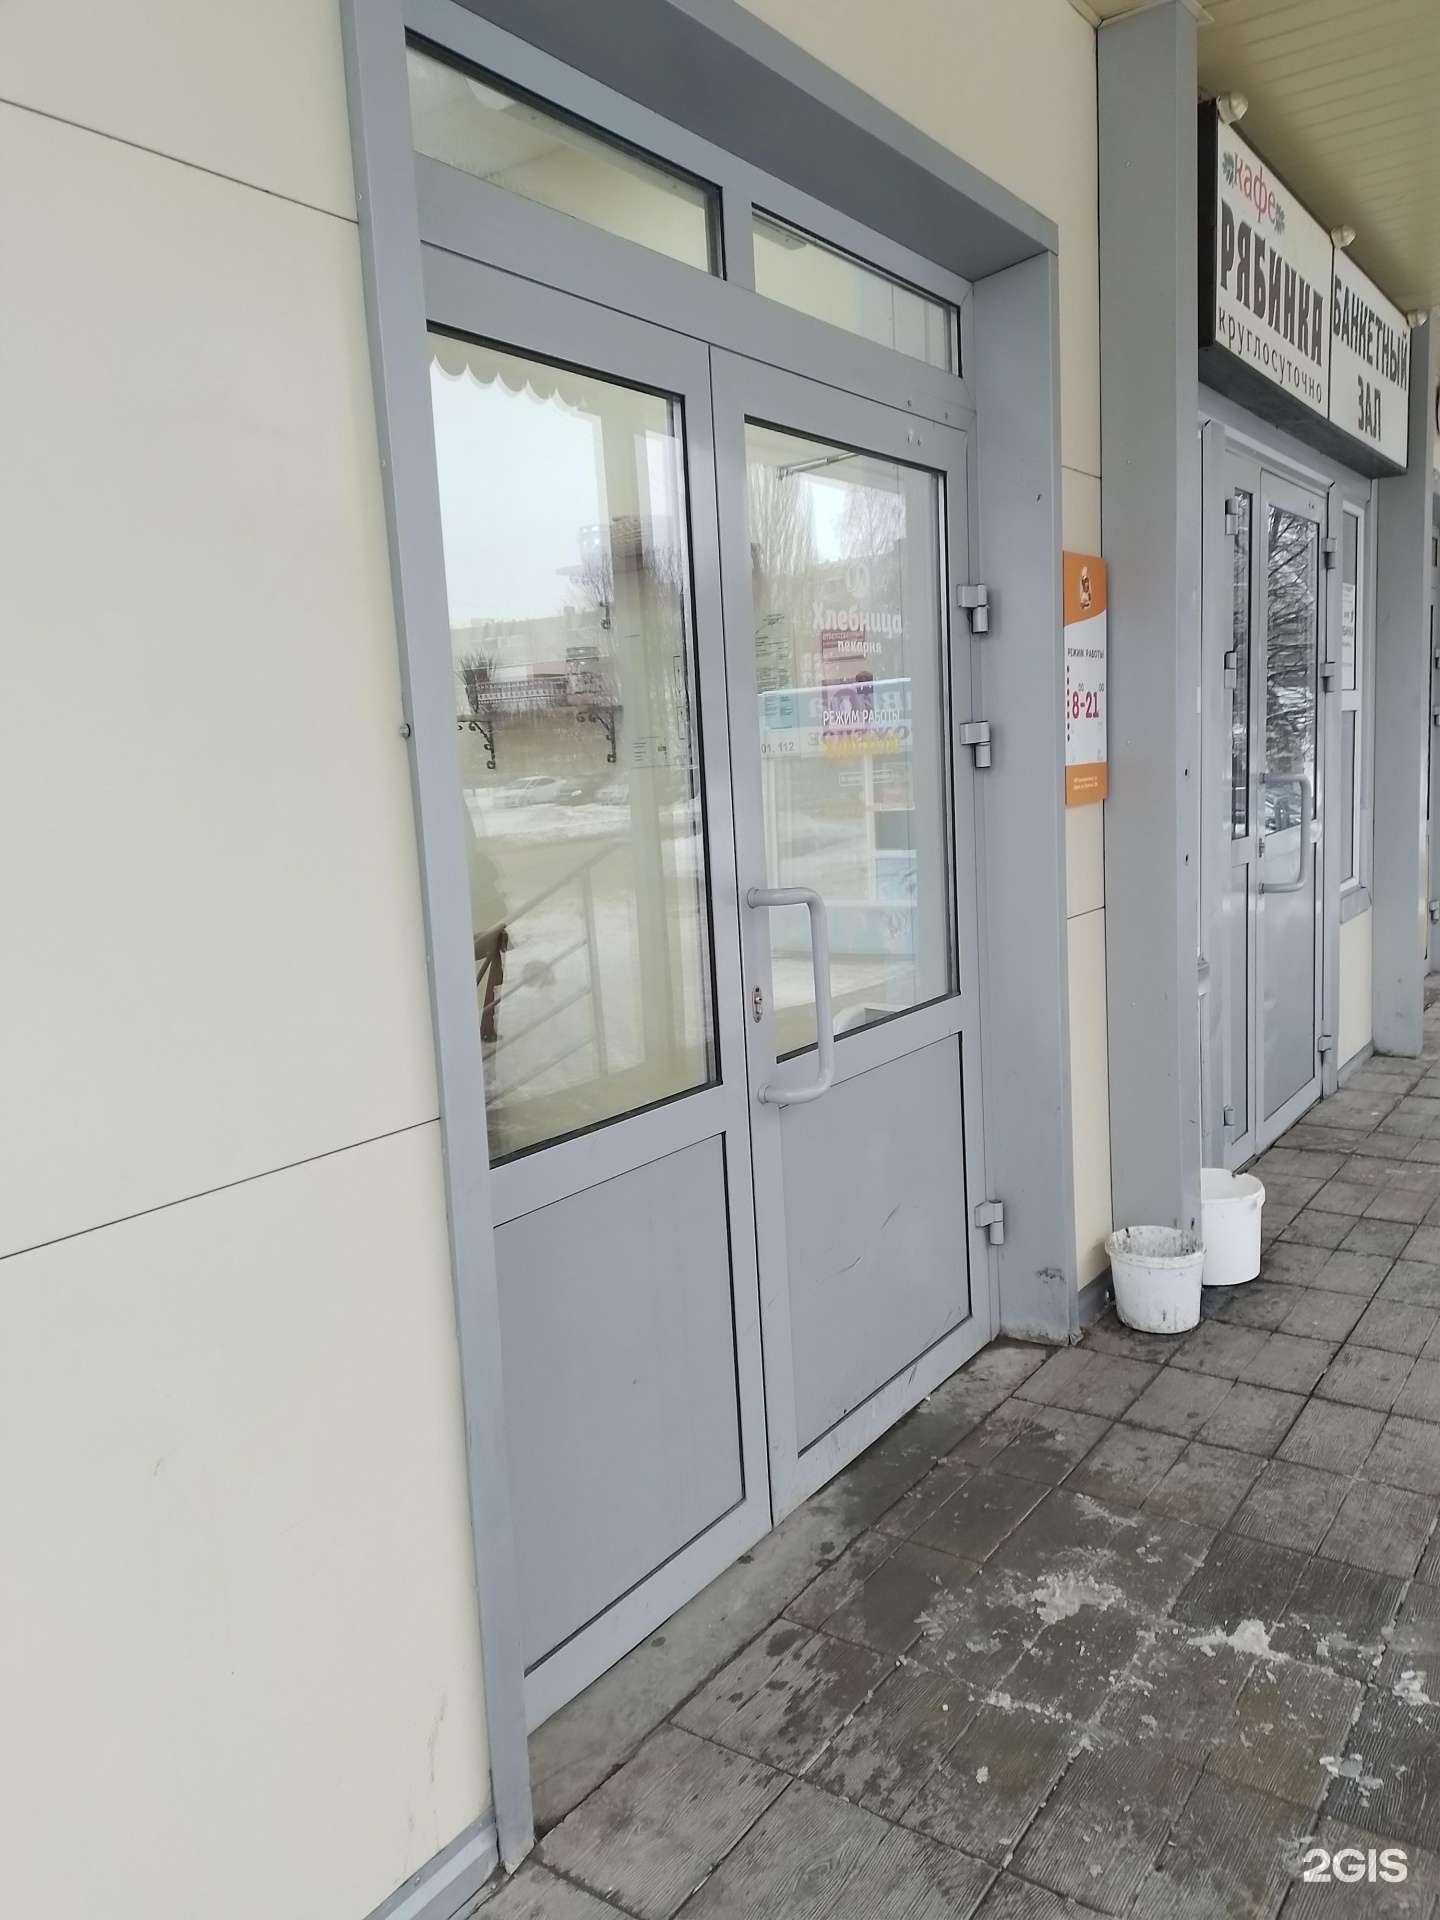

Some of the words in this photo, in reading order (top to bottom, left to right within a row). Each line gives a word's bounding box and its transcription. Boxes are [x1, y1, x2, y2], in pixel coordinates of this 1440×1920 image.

[1233, 152, 1277, 225] кафе
[1221, 199, 1324, 367] РЯБИНКА
[1218, 310, 1323, 404] круглосуточно
[1333, 275, 1408, 391] БАНКЕТНЫЙ
[1358, 376, 1382, 442] ЗАЛ
[812, 601, 903, 637] Хлебница
[838, 639, 882, 657] пекарня
[823, 709, 860, 726] РЕЖИМ
[863, 709, 900, 723] РАБОТЫ
